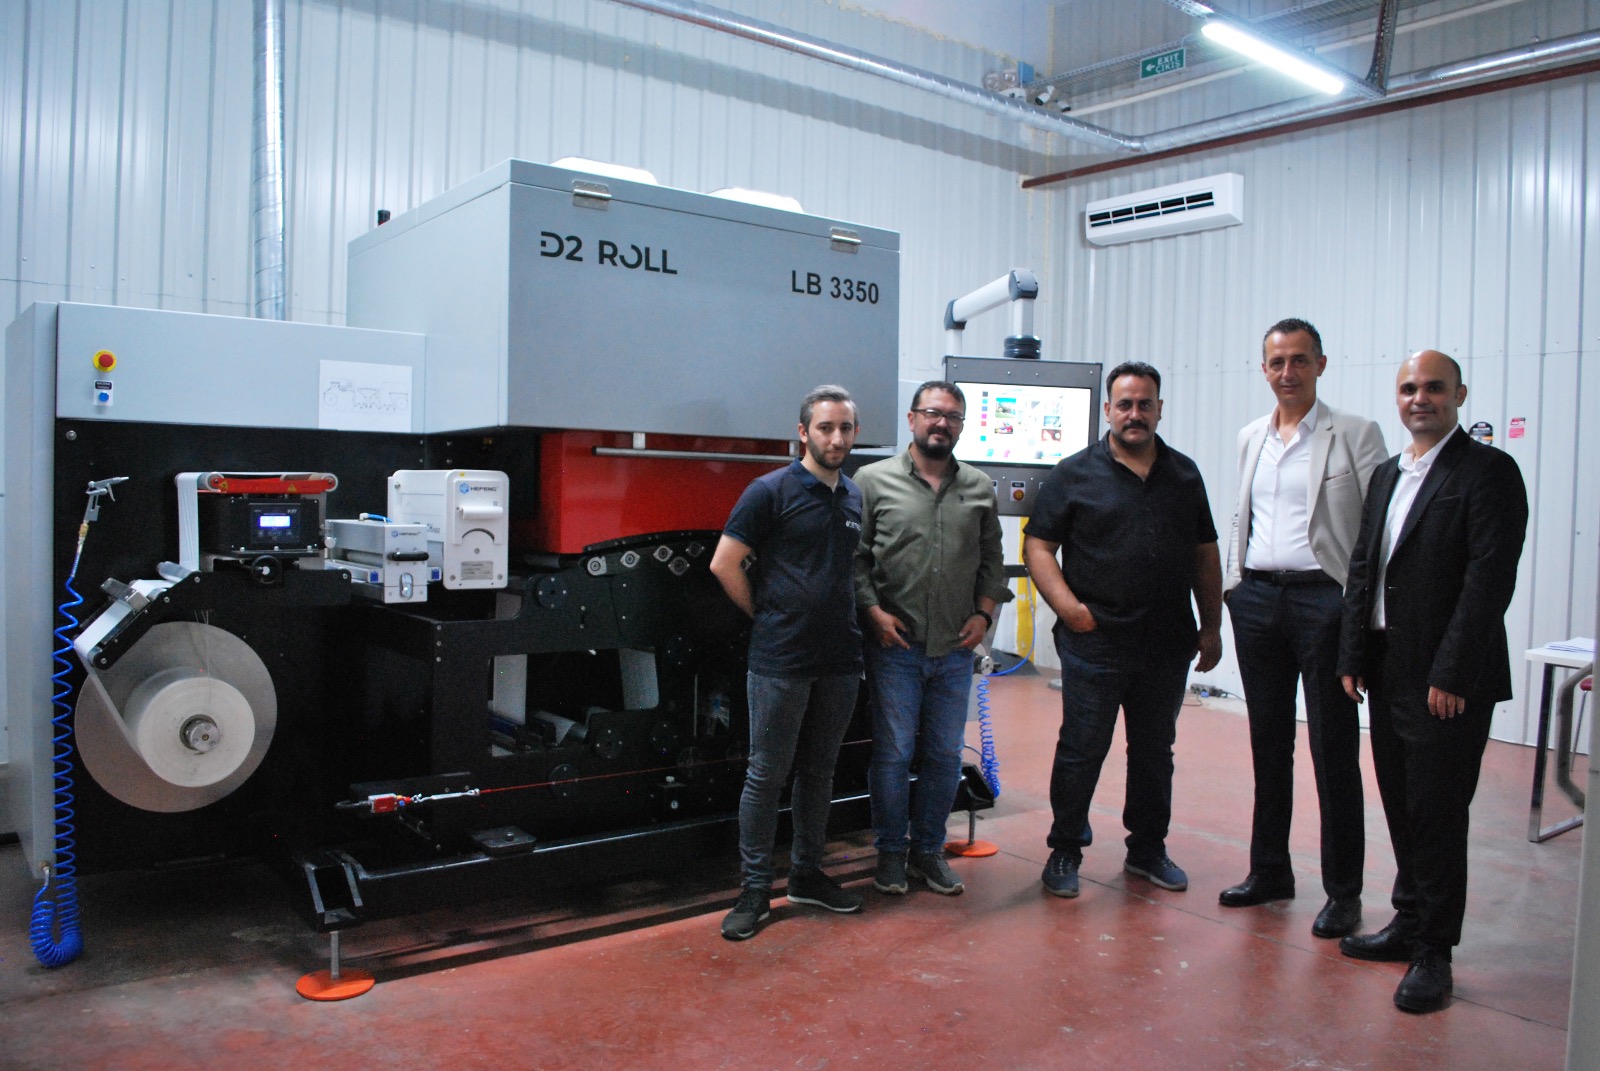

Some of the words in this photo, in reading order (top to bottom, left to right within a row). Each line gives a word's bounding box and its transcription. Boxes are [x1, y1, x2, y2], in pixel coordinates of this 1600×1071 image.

[1158, 52, 1180, 65] EXIT
[540, 230, 583, 262] D2
[598, 239, 678, 275] ROLL
[792, 270, 822, 296] LB
[830, 276, 879, 305] 3350
